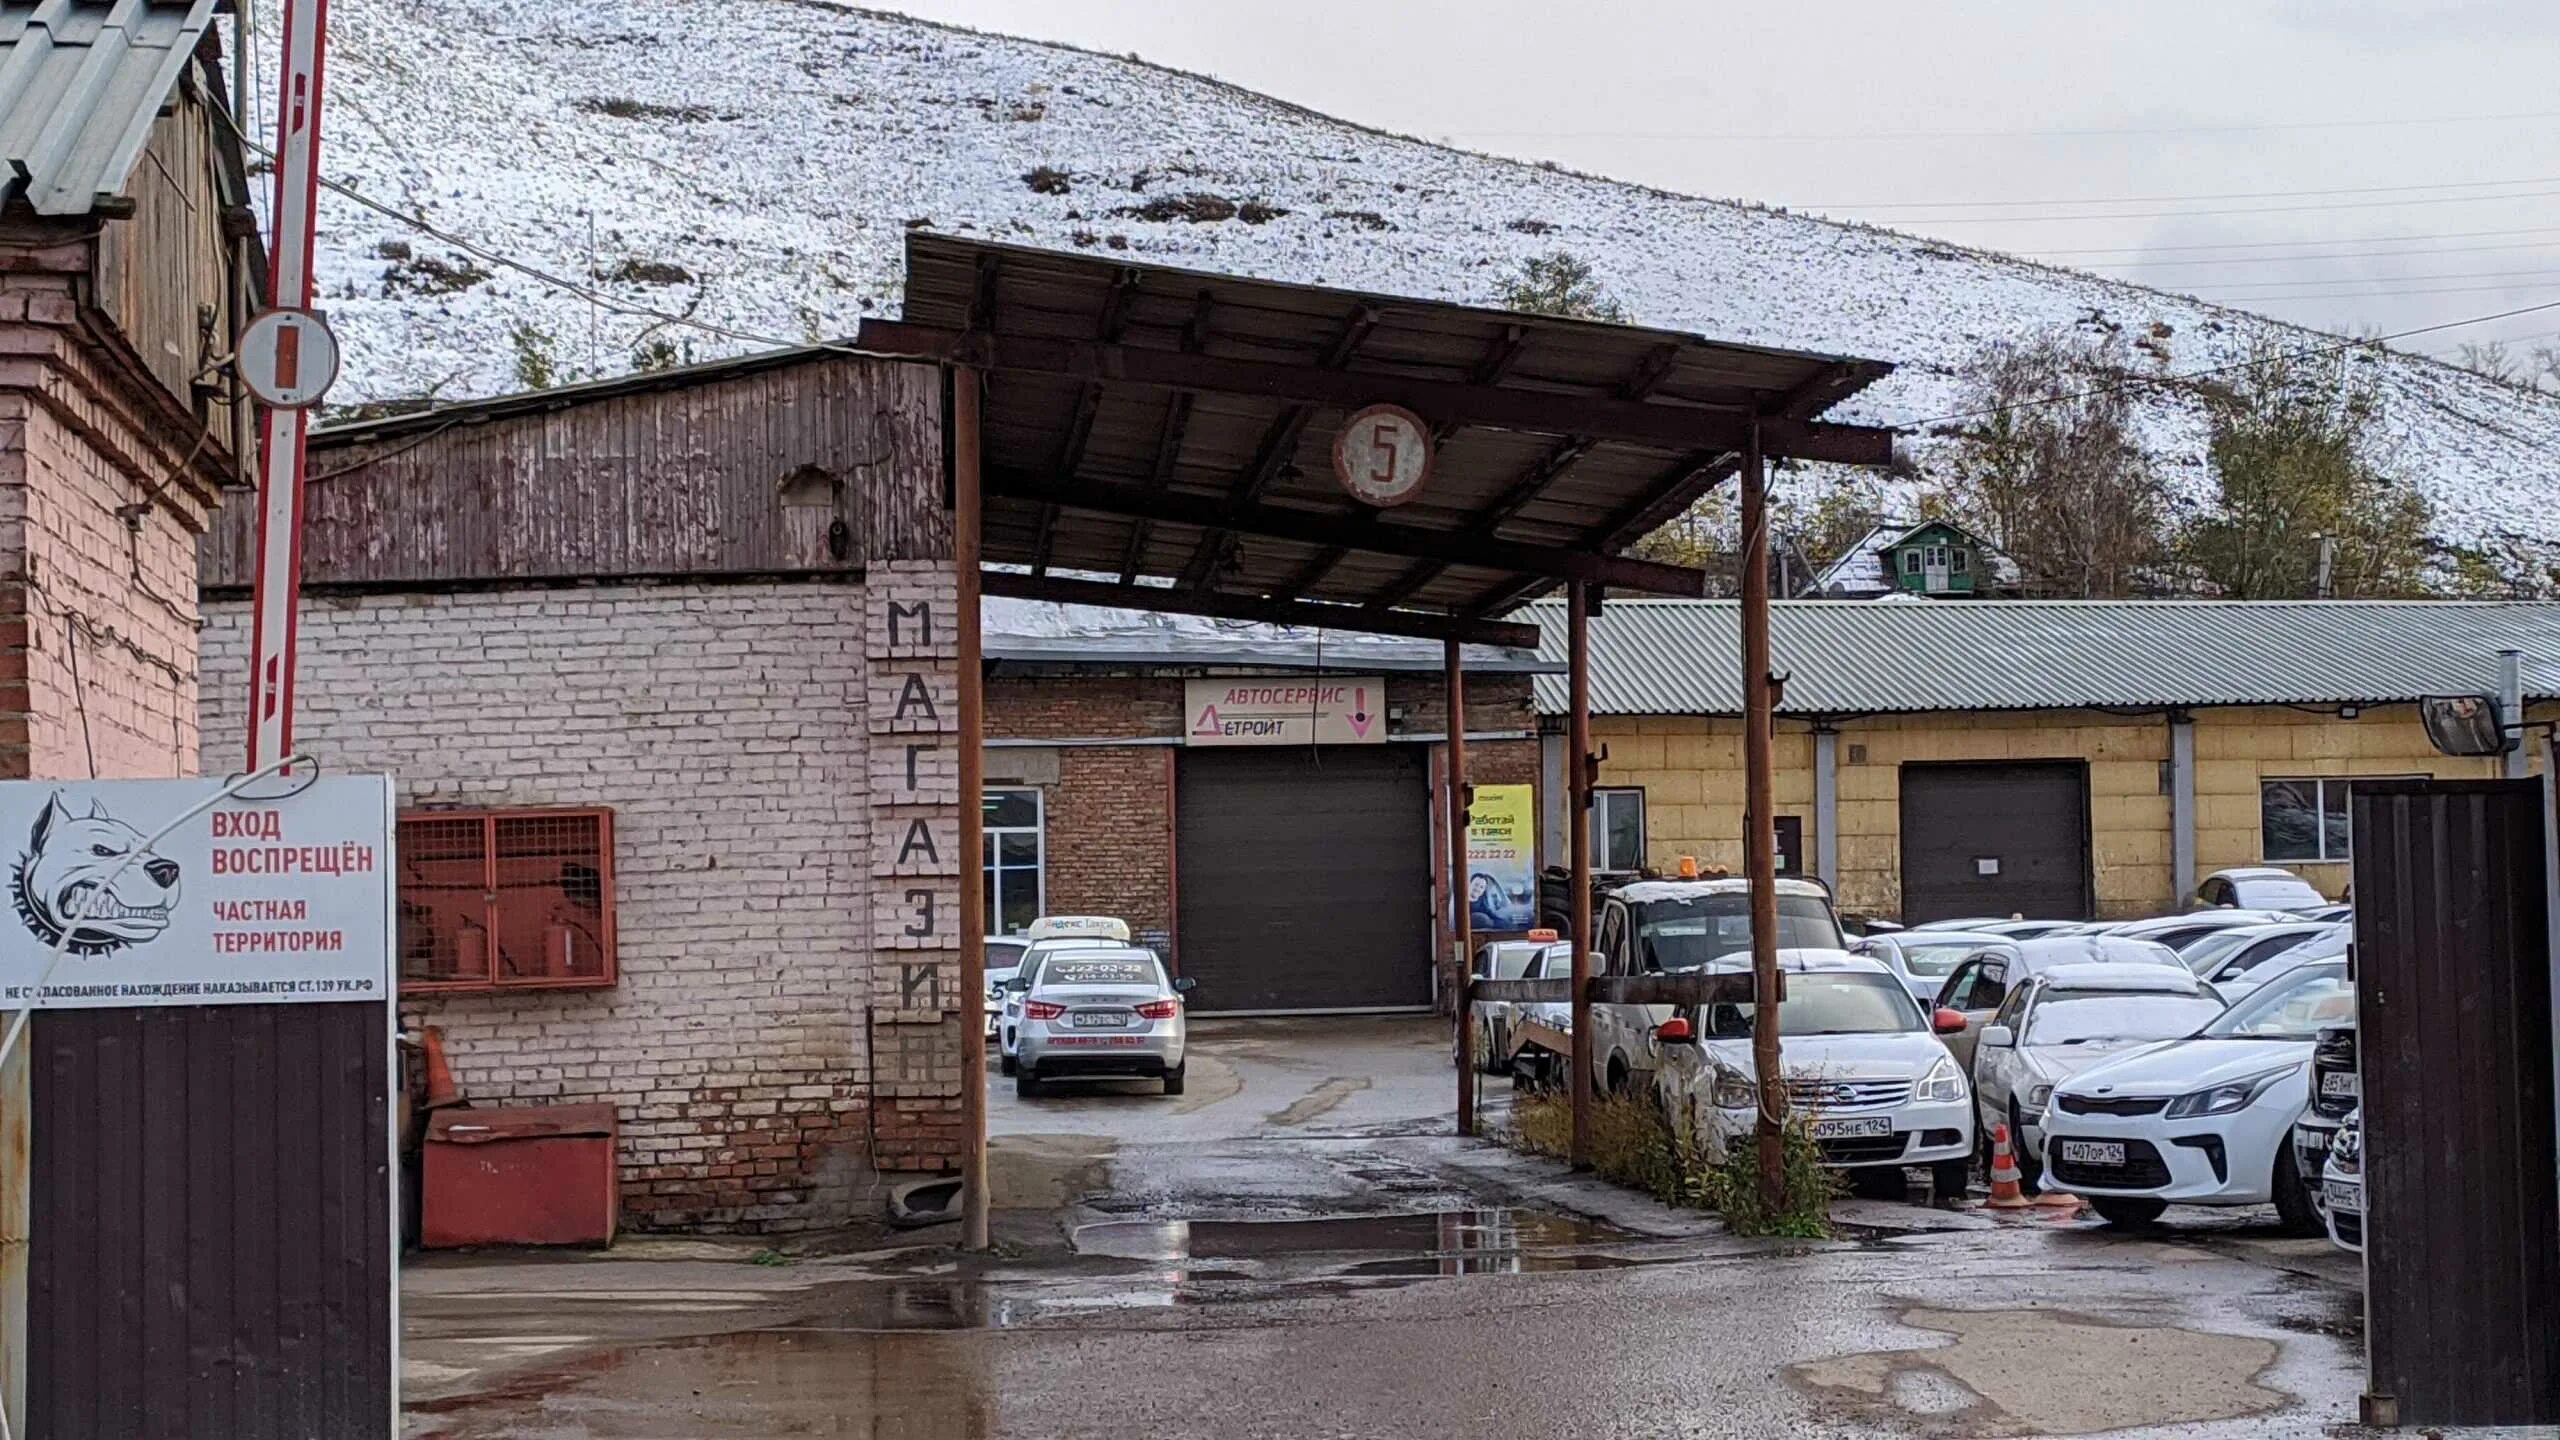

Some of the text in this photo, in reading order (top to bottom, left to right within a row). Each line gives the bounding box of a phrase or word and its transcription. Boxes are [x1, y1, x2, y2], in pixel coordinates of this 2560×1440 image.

[1370, 424, 1398, 483] 5
[1224, 686, 1346, 705] АВТОСЕРВИС
[212, 811, 282, 842] ВХОД
[212, 841, 373, 877] ВОСПРЕЩЁН
[213, 900, 306, 922] ЧАСТНАЯ
[213, 930, 343, 954] ТЕРРИТОРИЯ
[5, 987, 19, 999] НЕ
[121, 983, 201, 997] НАХОЖДЕНИЕ
[203, 981, 295, 995] НАКАЗЫВАЕТСЯ
